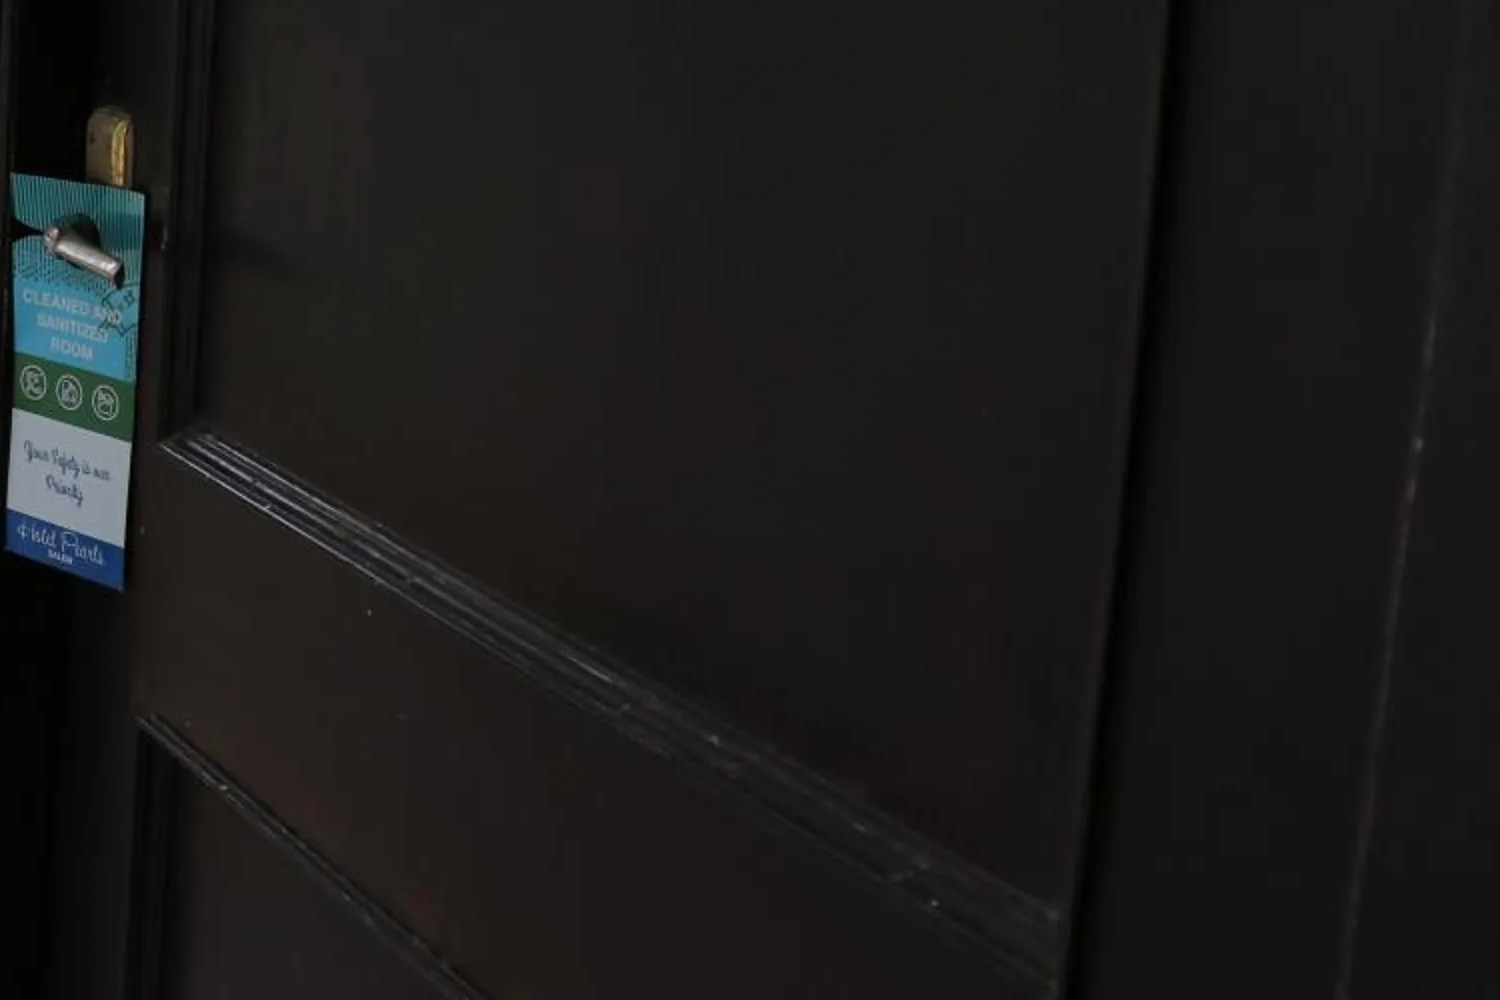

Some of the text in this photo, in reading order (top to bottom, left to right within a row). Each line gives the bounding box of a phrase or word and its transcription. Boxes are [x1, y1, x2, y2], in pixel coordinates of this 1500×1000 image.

[23, 289, 122, 325] CLEANED AND
[36, 312, 109, 343] SANITIZED
[51, 337, 93, 360] ROOM
[23, 439, 49, 463] Your
[51, 447, 80, 479] Safety
[45, 474, 83, 508] Priority
